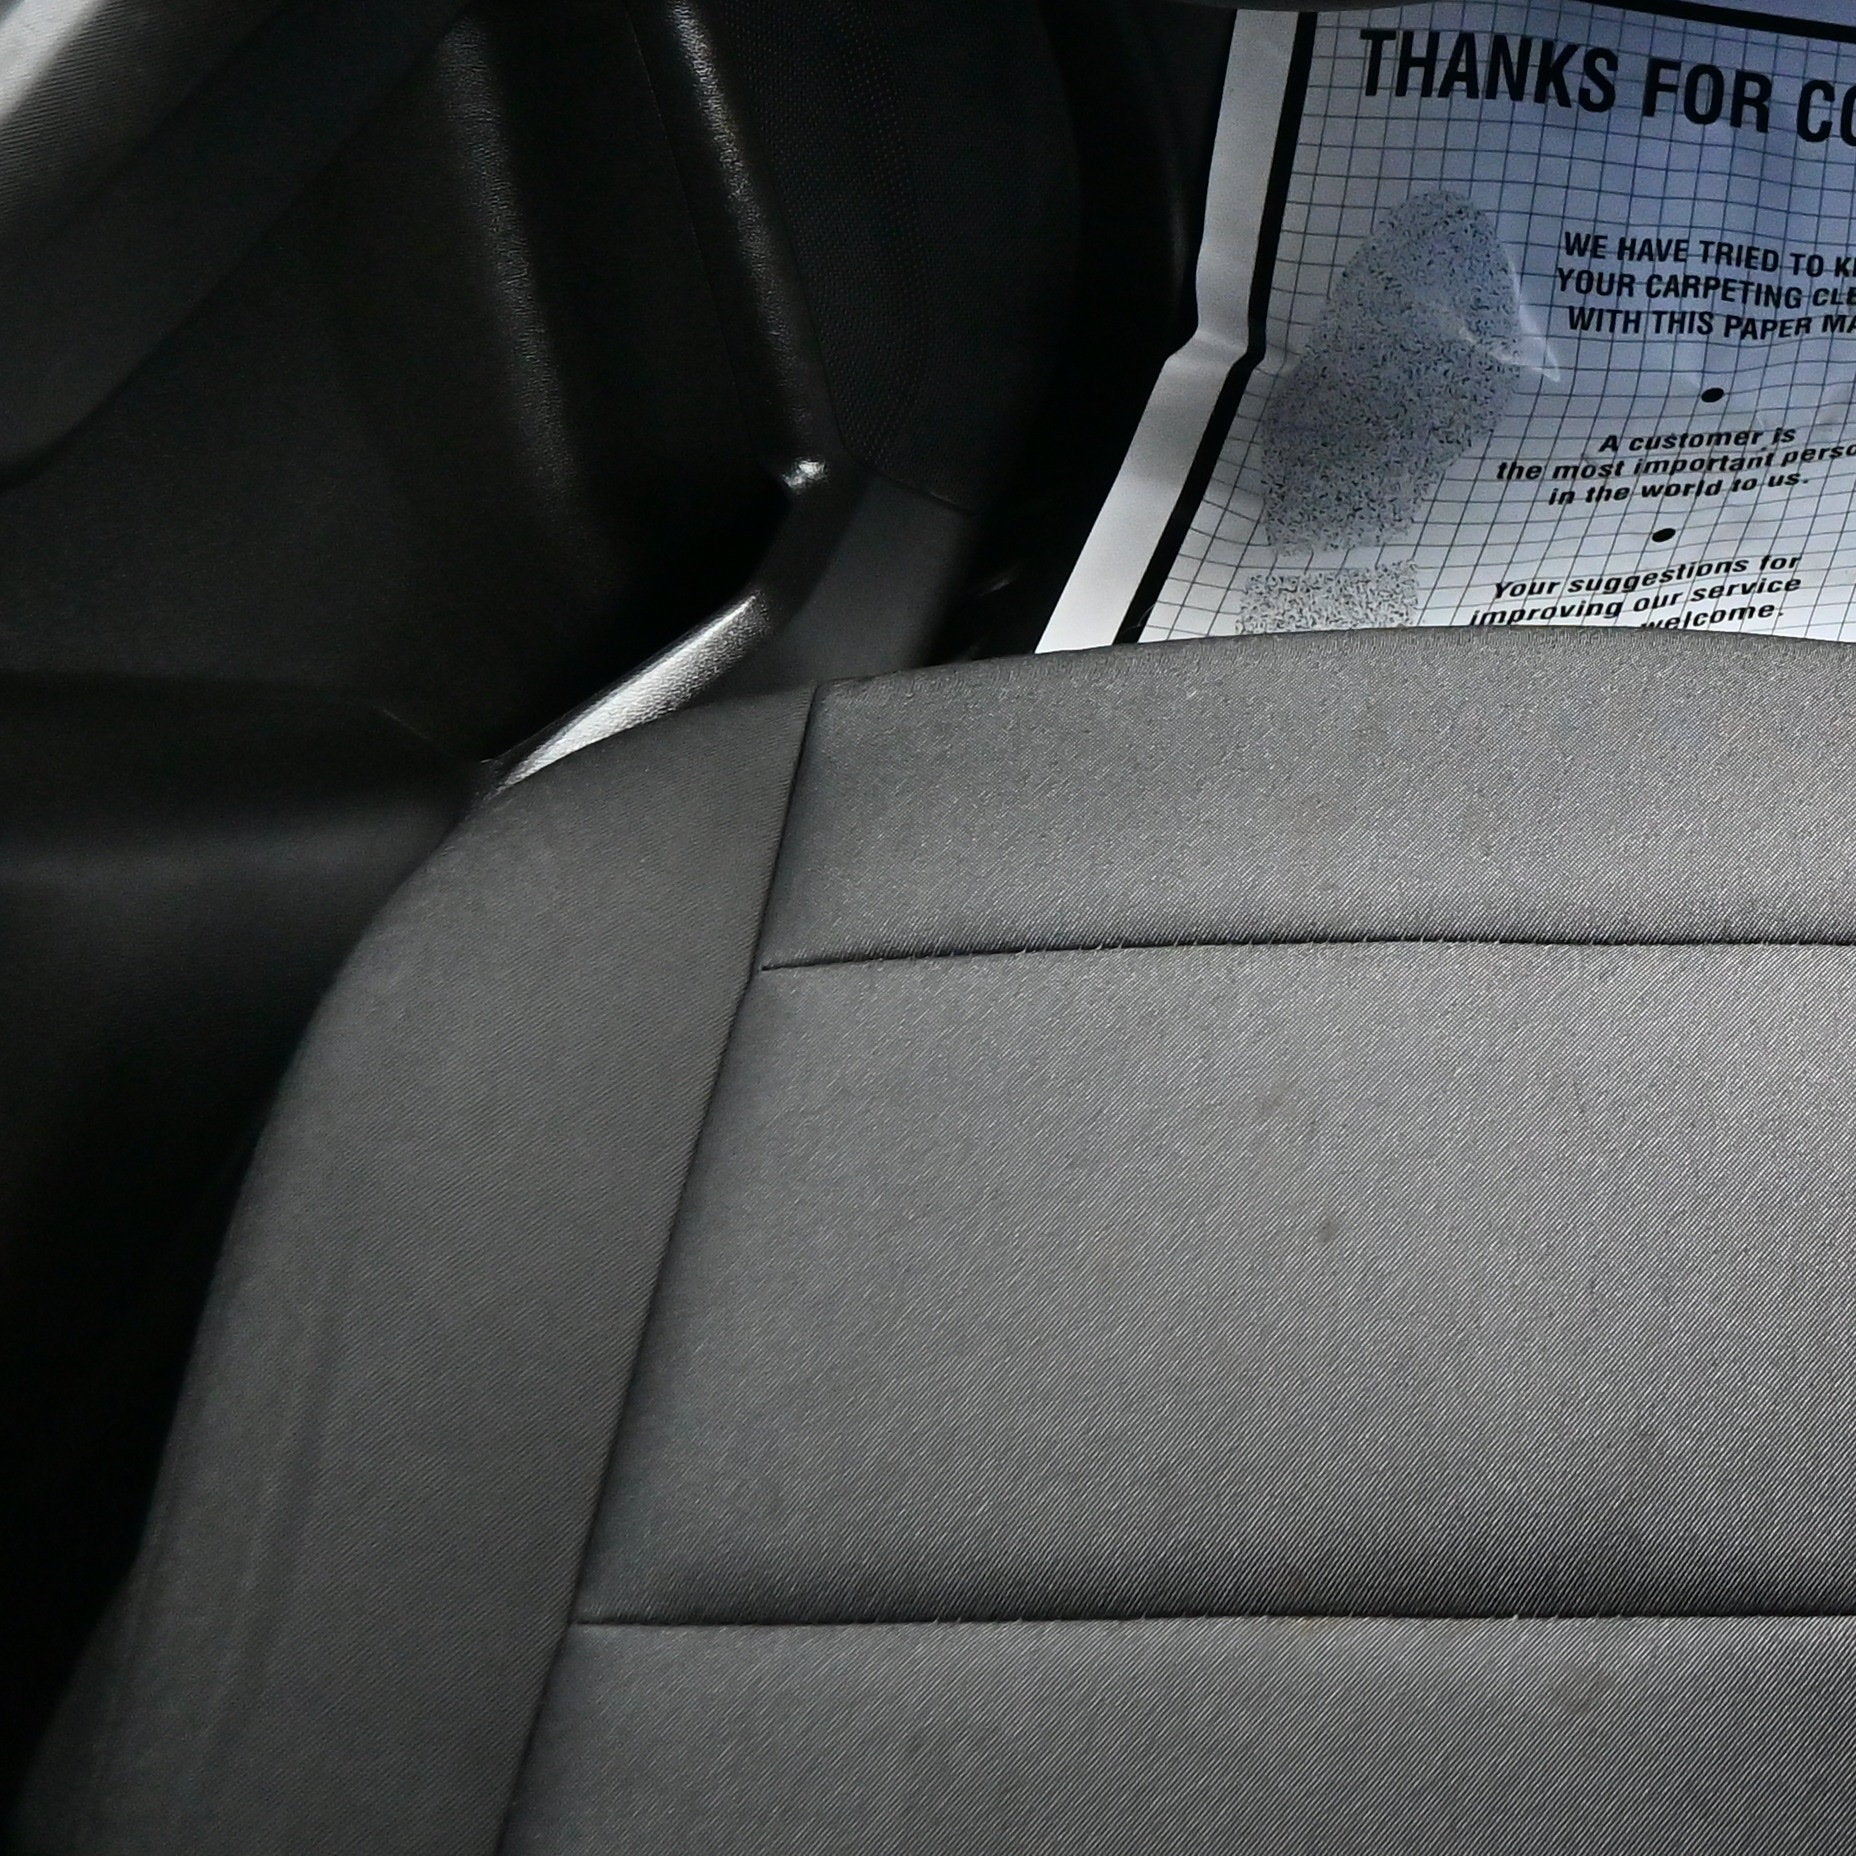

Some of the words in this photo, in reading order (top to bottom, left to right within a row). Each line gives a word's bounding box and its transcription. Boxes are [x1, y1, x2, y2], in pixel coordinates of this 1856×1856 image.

[1359, 28, 1619, 113] THANKS
[1642, 58, 1771, 133] FOR
[1564, 231, 1608, 259] WE
[1617, 236, 1689, 263] HAVE
[1699, 240, 1779, 272] TRIED
[1790, 253, 1824, 277] TO
[1556, 267, 1636, 297] YOUR
[1646, 273, 1802, 309] CARPETING
[1567, 306, 1641, 333] WITH
[1652, 310, 1714, 335] THIS
[1723, 315, 1812, 340] PAPER
[1598, 434, 1619, 452] A
[1628, 430, 1765, 452] customer
[1771, 427, 1797, 444] is
[1496, 461, 1543, 481] the
[1551, 459, 1625, 480] most
[1633, 451, 1774, 477] important
[1548, 487, 1575, 506] in
[1585, 485, 1630, 503] the
[1641, 480, 1721, 499] world
[1732, 477, 1758, 493] to
[1767, 470, 1809, 487] us.
[1494, 579, 1561, 599] Your
[1567, 556, 1750, 594] suggestions
[1759, 554, 1804, 572] for
[1469, 600, 1623, 626] improving
[1632, 592, 1683, 612] our
[1690, 576, 1802, 603] service
